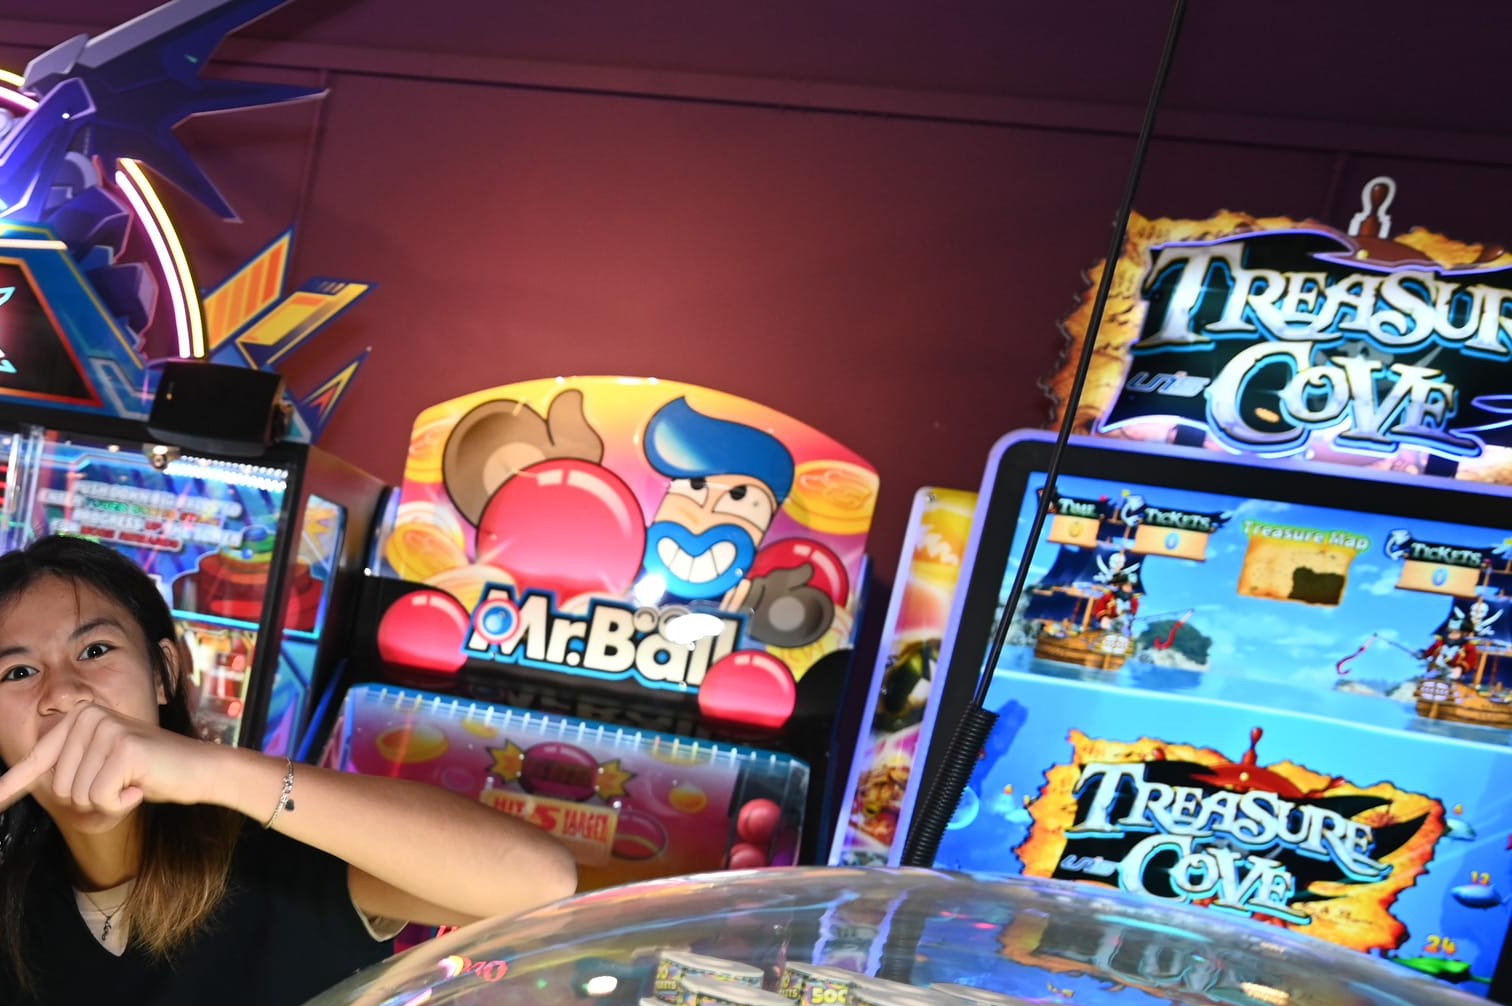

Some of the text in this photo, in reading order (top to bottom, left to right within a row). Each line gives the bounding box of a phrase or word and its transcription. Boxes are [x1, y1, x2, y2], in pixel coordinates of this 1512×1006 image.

[1205, 341, 1482, 452] COVE
[1146, 508, 1212, 532] TICKETS
[1243, 520, 1369, 551] Treasure Map
[1412, 542, 1482, 566] TICKETS
[1066, 762, 1392, 879] TREASURE
[1119, 834, 1311, 923] COVE
[1423, 934, 1456, 955] 24
